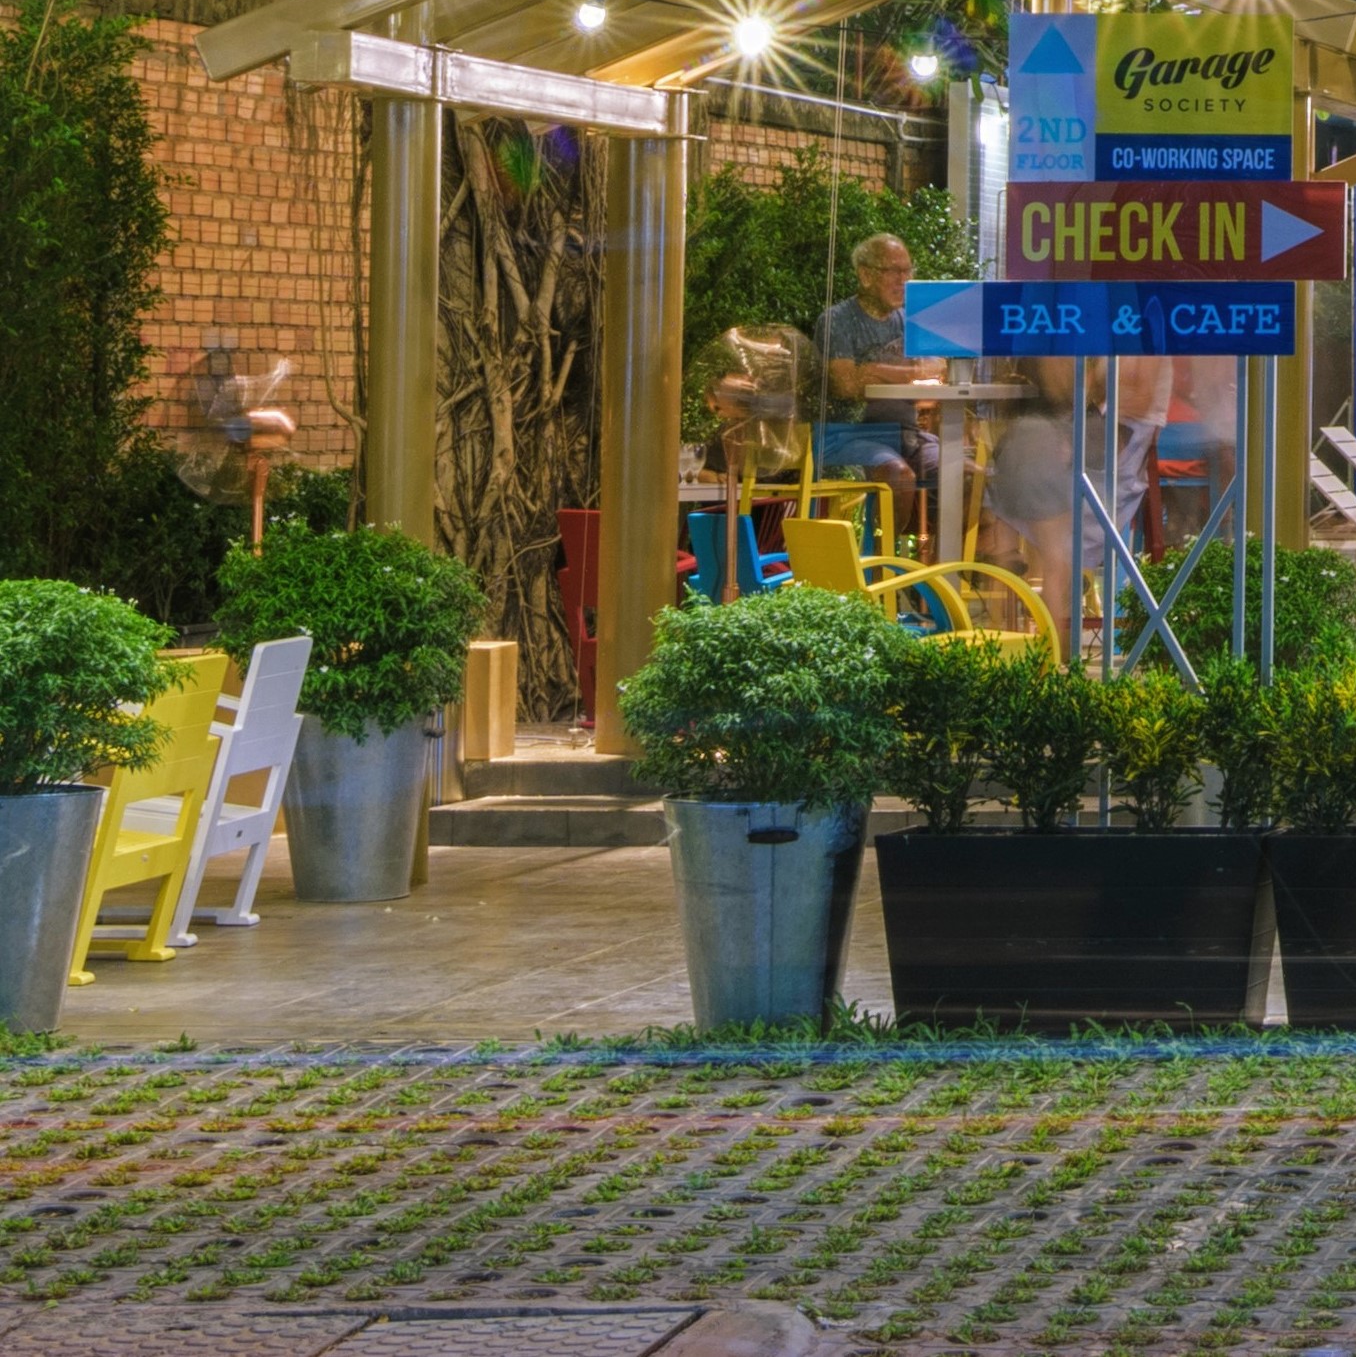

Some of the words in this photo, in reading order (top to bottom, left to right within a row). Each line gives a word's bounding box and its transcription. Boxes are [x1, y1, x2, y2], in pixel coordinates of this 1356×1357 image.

[1114, 47, 1275, 100] Garage
[1144, 98, 1246, 112] SOCIETY
[1017, 115, 1087, 143] 2ND
[1016, 153, 1085, 170] FLOOR
[1112, 147, 1218, 169] CO-WORKING
[1222, 148, 1275, 169] SPACE
[1021, 201, 1184, 262] CHECK
[1198, 201, 1246, 262] IN
[1000, 303, 1086, 335] BAR
[1111, 304, 1142, 335] &
[1170, 303, 1281, 335] CAFE
